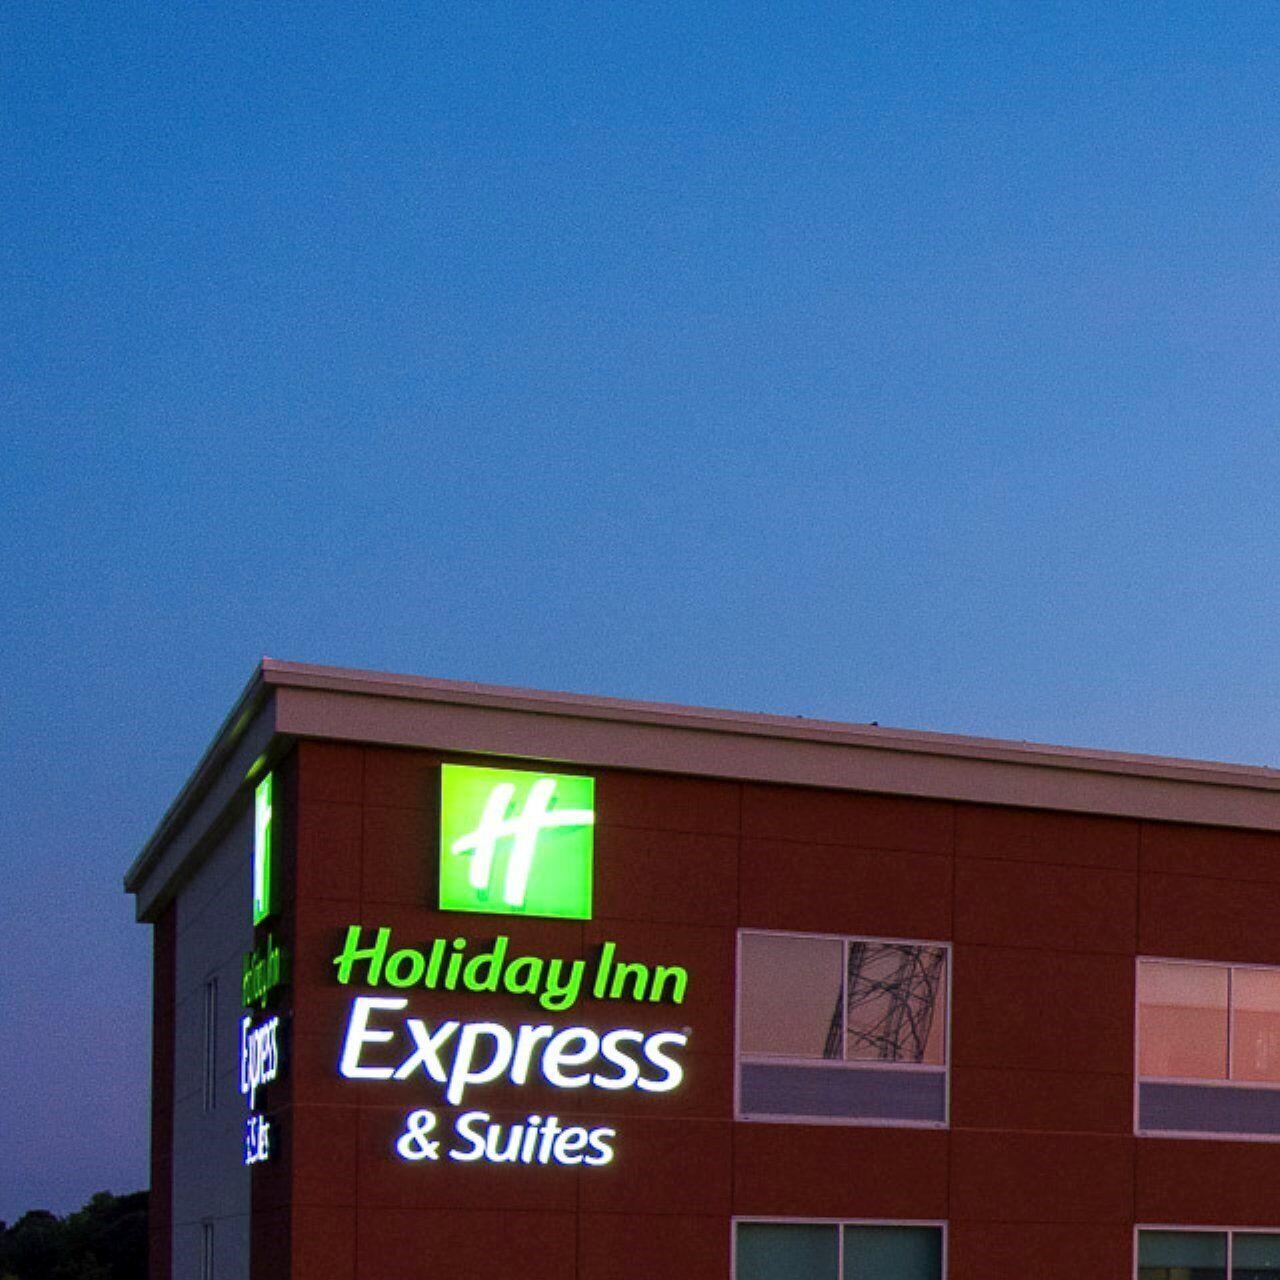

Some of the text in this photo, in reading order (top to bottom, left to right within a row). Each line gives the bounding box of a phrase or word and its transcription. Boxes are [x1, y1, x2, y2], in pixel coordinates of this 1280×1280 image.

[333, 925, 586, 1011] Holiday
[593, 941, 689, 1004] Inn
[338, 996, 689, 1106] Express
[396, 1109, 617, 1167] & Suites
